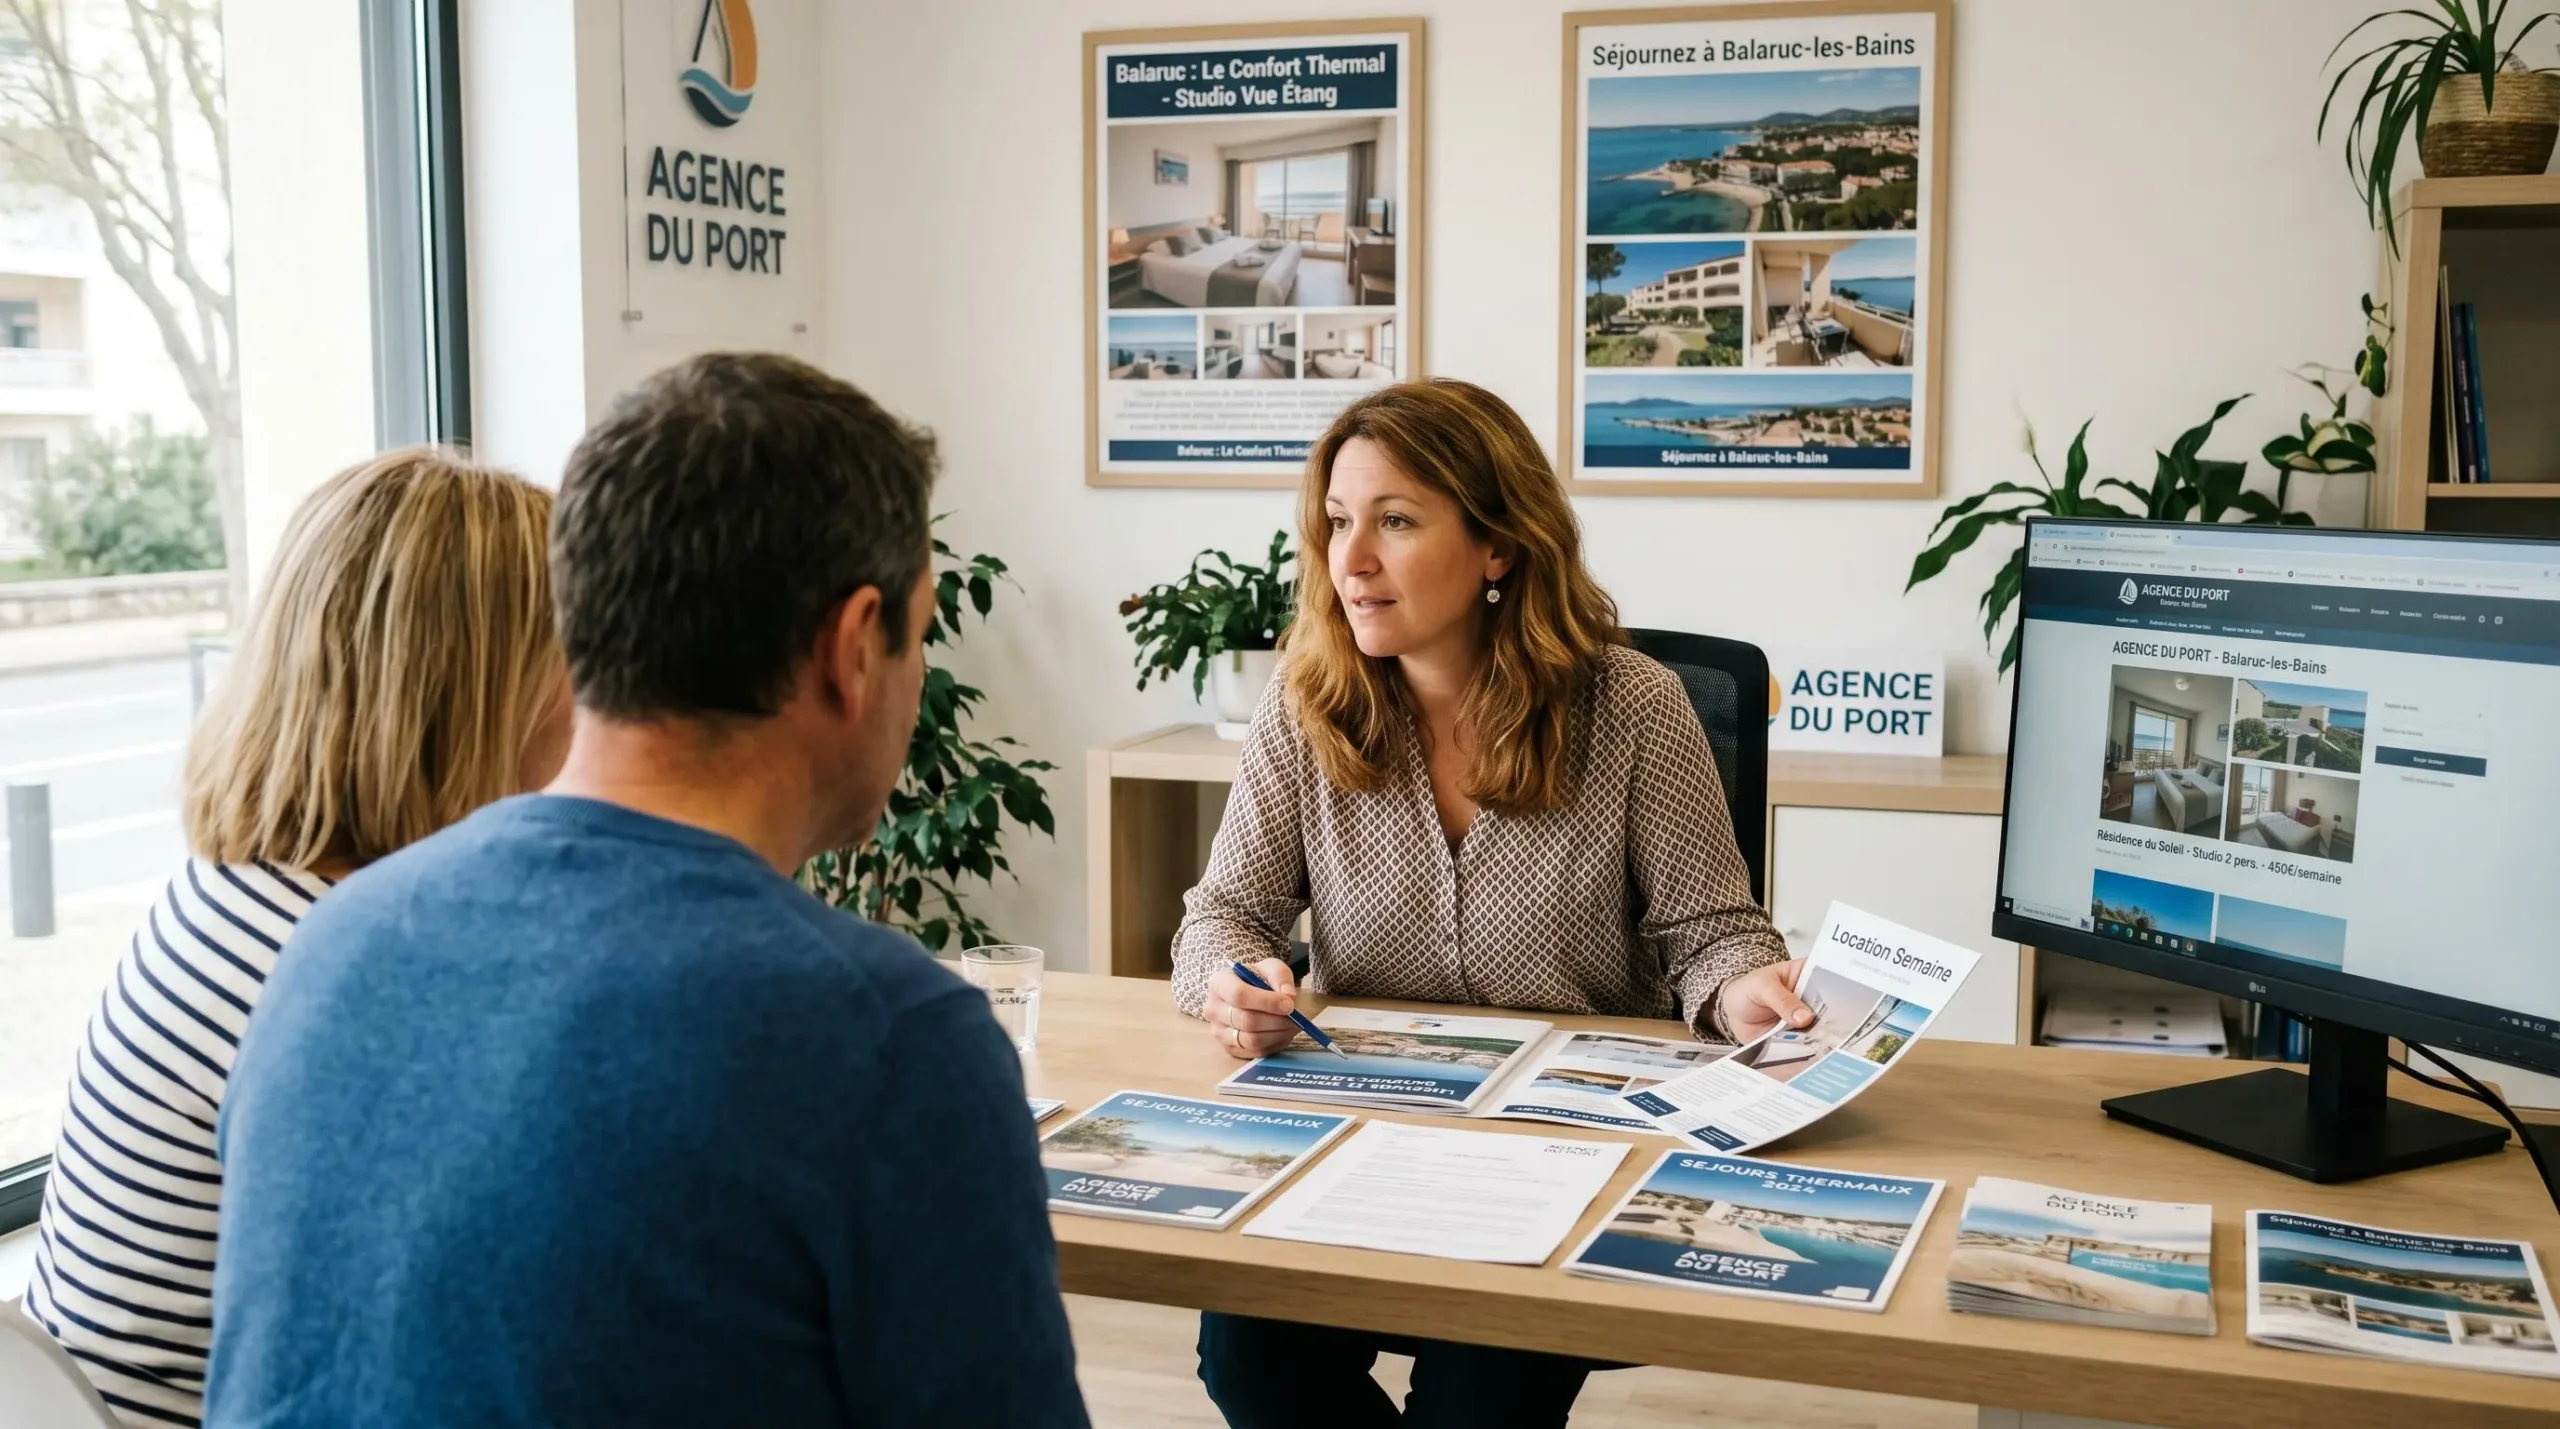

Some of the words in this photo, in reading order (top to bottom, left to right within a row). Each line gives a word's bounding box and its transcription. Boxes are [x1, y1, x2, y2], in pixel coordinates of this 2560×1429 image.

[1115, 63, 1186, 83] Balaruc
[1202, 61, 1223, 80] Le
[1229, 55, 1301, 79] Confort
[1305, 51, 1385, 75] Thermal
[1592, 43, 1696, 70] Séjournez
[1703, 40, 1715, 62] à
[1722, 33, 1915, 61] Balaruc-les-Bains
[1174, 87, 1237, 108] Studio
[1240, 85, 1278, 105] Vue
[1282, 79, 1338, 107] Étang
[647, 146, 786, 216] AGENCE
[647, 212, 694, 266] DU
[706, 220, 786, 275] PORT
[2141, 584, 2182, 599] AGENCE
[2184, 586, 2199, 599] DU
[2201, 588, 2230, 602] PORT
[2112, 640, 2158, 658] AGENCE
[2161, 644, 2177, 659] DU
[2179, 647, 2212, 662] PORT
[2222, 651, 2327, 674] Balaruc-les-Bains
[1791, 669, 1933, 701] AGENCE
[1790, 705, 1833, 732] DU
[1844, 708, 1932, 736] PORT
[2097, 829, 2142, 847] Résidence
[2144, 838, 2156, 850] du
[2159, 840, 2184, 855] Soleil
[2192, 846, 2223, 862] Studio
[2225, 852, 2232, 864] 2
[2233, 856, 2259, 870] pers.
[2268, 860, 2342, 884] 450€/semaine
[1831, 923, 1892, 961] Location
[1892, 947, 1953, 983] Semaine
[1121, 1098, 1208, 1118] SEJOURS
[1213, 1110, 1324, 1129] THERMAUX
[1185, 1116, 1233, 1128] 2024
[1061, 1183, 1094, 1194] DU
[1095, 1188, 1158, 1202] PORT
[1071, 1177, 1165, 1195] AGENCE
[1679, 1158, 1779, 1180] SEJOURS
[1786, 1173, 1914, 1196] THERMAUX
[1762, 1180, 1816, 1195] 2024
[2046, 1201, 2075, 1211] DU
[2082, 1207, 2138, 1220] PORT
[2048, 1194, 2139, 1214] AGENCE
[1674, 1258, 1712, 1271] DU
[1717, 1264, 1786, 1281] PORT
[1680, 1251, 1790, 1274] AGENCE
